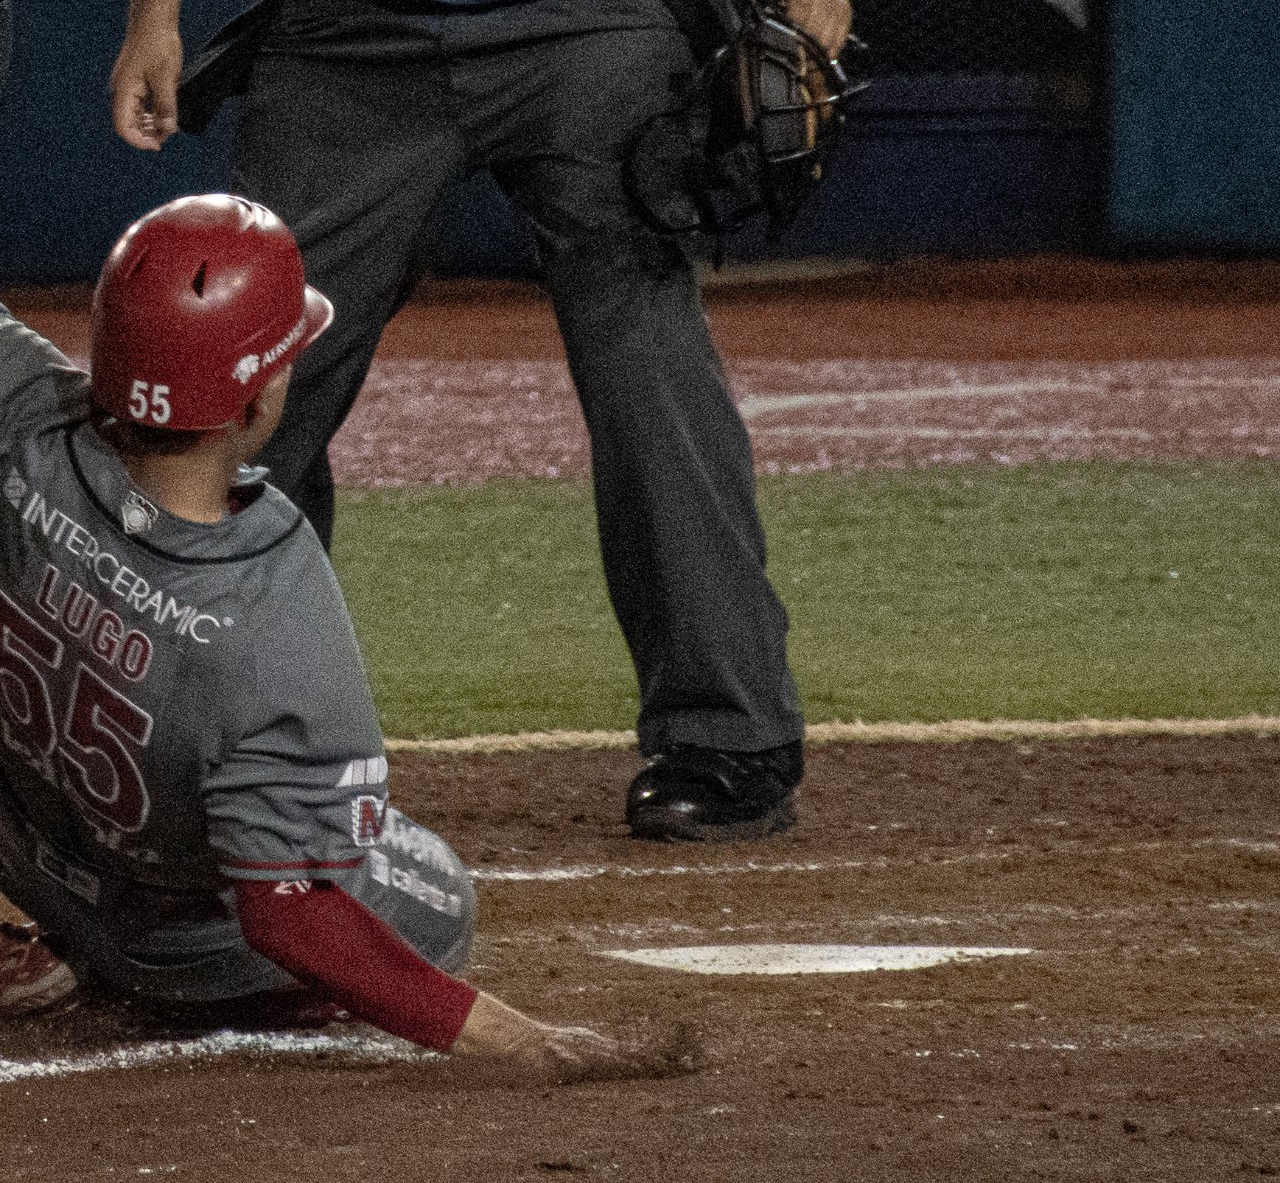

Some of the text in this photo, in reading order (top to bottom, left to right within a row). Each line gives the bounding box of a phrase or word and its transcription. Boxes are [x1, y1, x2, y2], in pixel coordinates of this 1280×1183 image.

[129, 379, 171, 424] 55
[22, 491, 221, 644] INTERCERAMIC
[36, 563, 153, 682] LUGO
